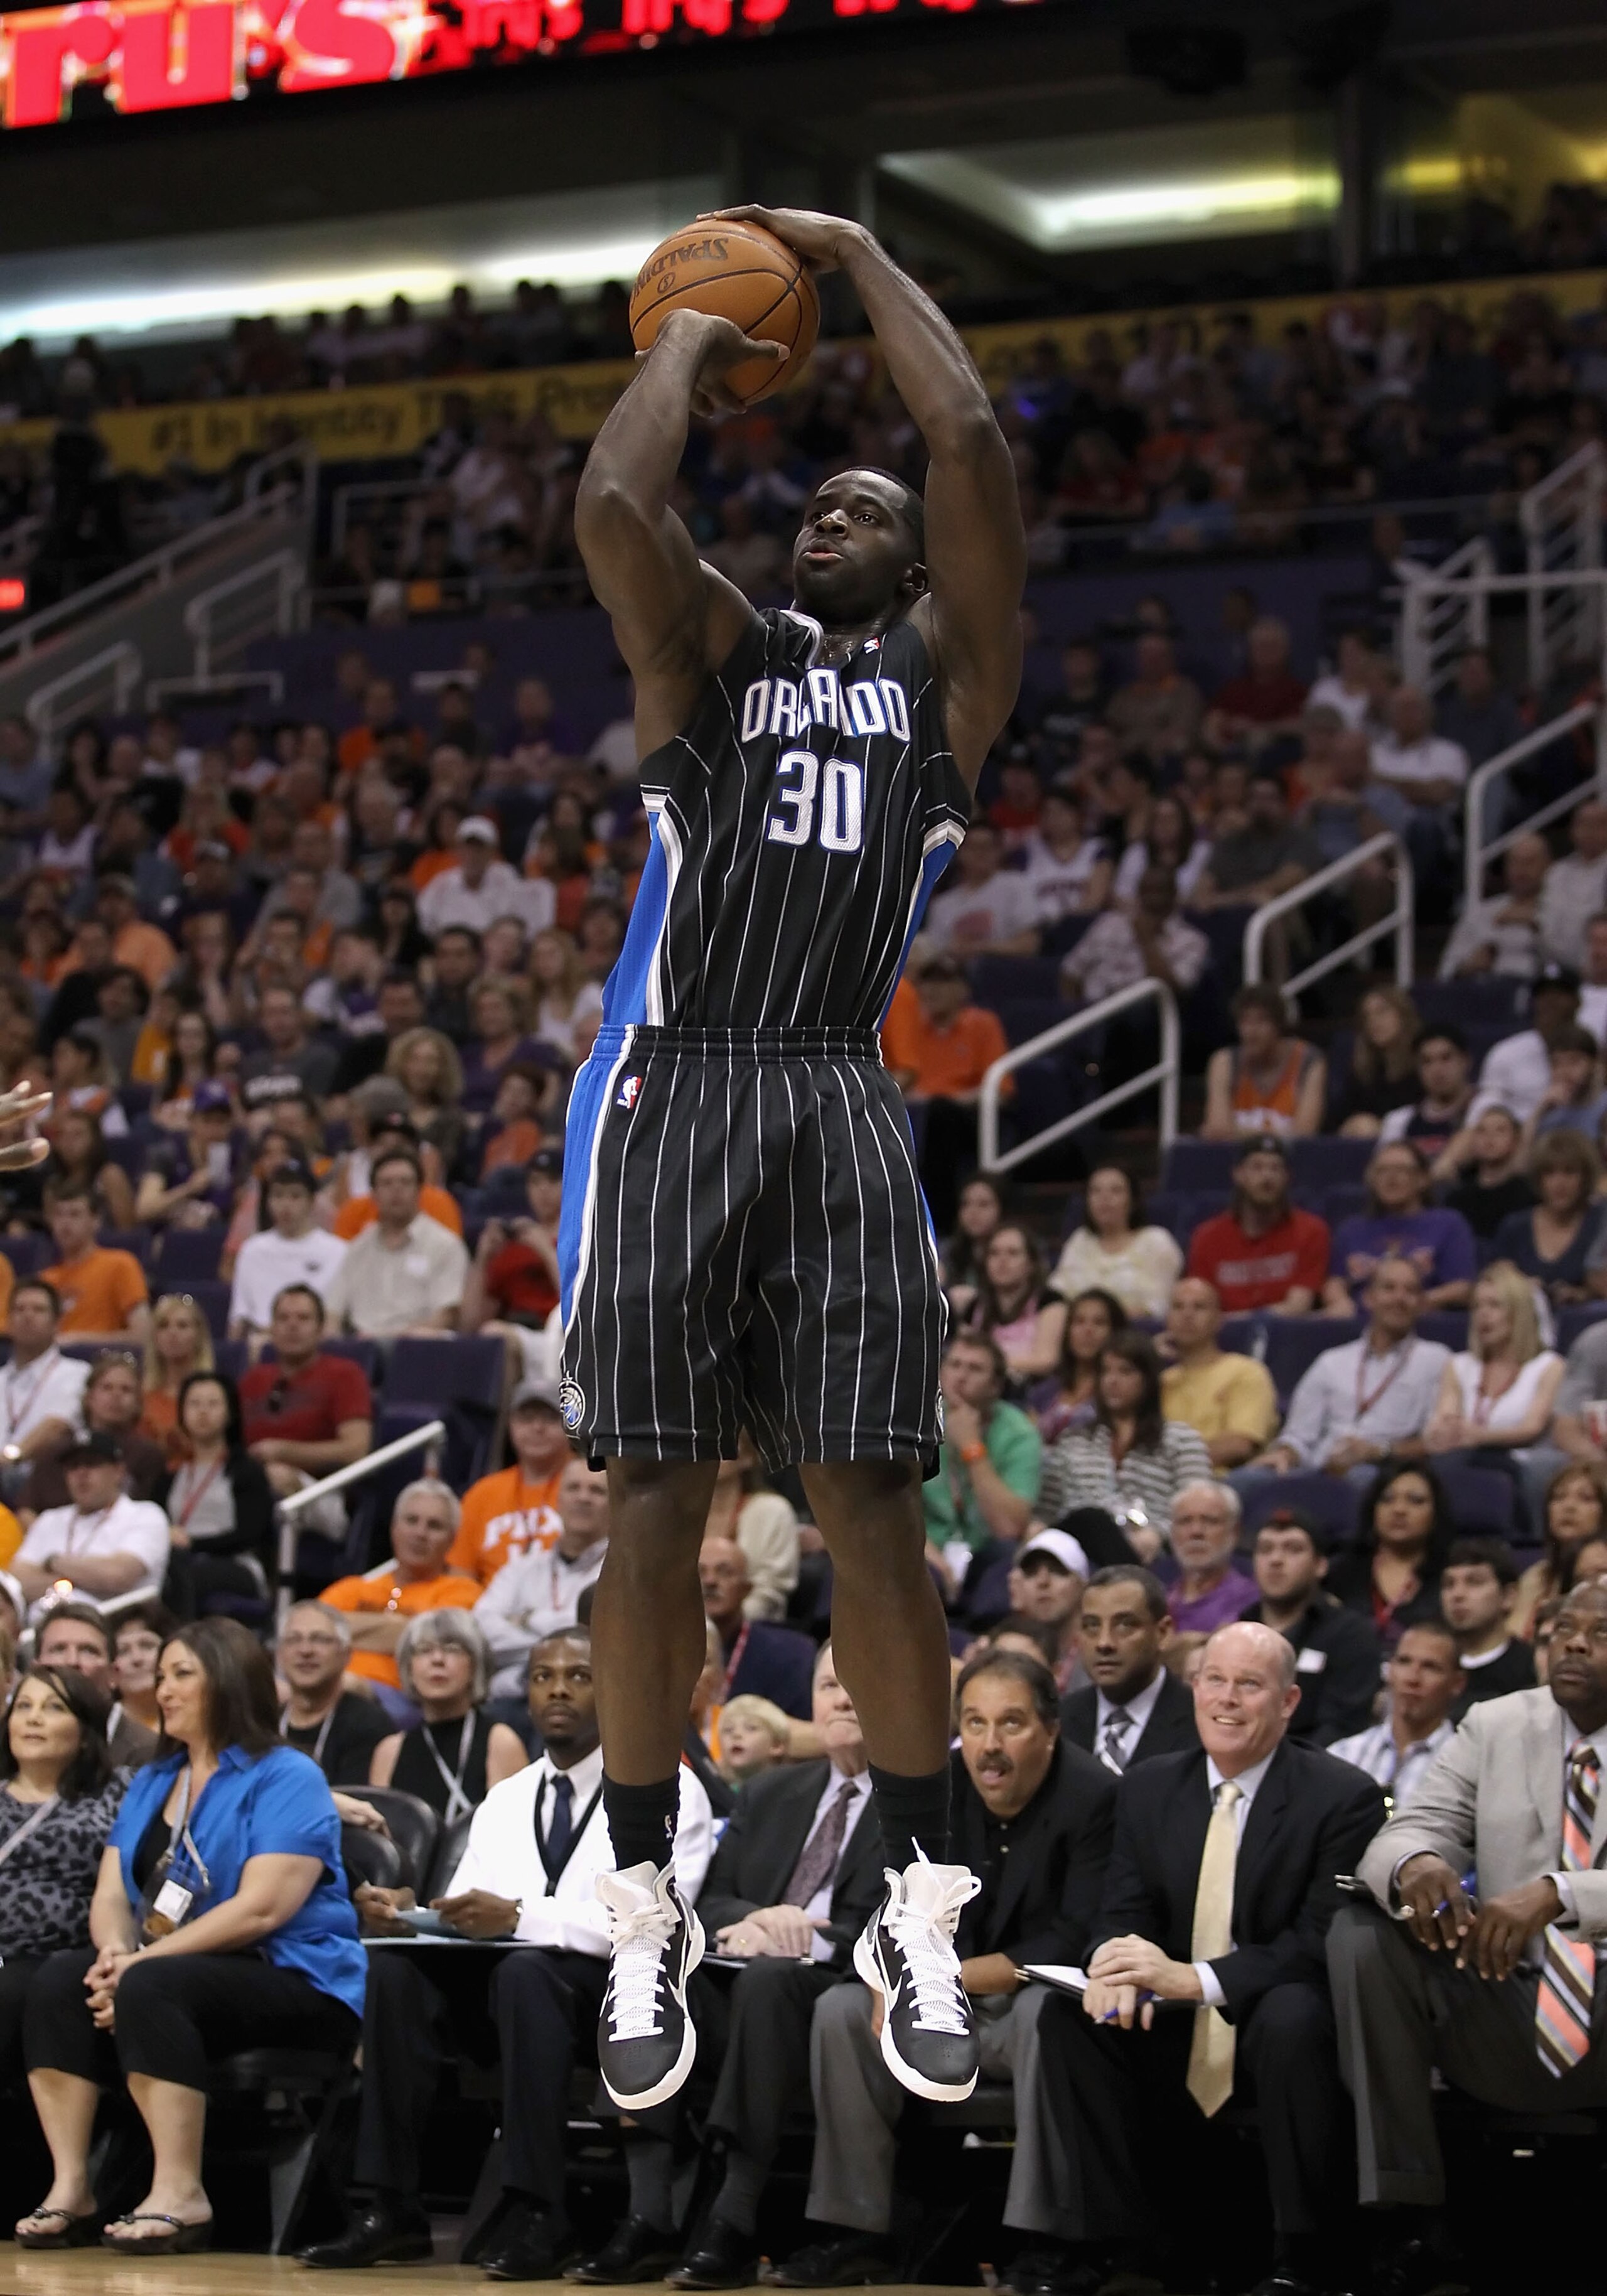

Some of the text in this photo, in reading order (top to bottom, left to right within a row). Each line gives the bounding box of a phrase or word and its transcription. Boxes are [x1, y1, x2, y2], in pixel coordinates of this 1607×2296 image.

[630, 238, 729, 299] SPALDIN
[252, 403, 403, 443] Intity
[767, 749, 864, 854] 30
